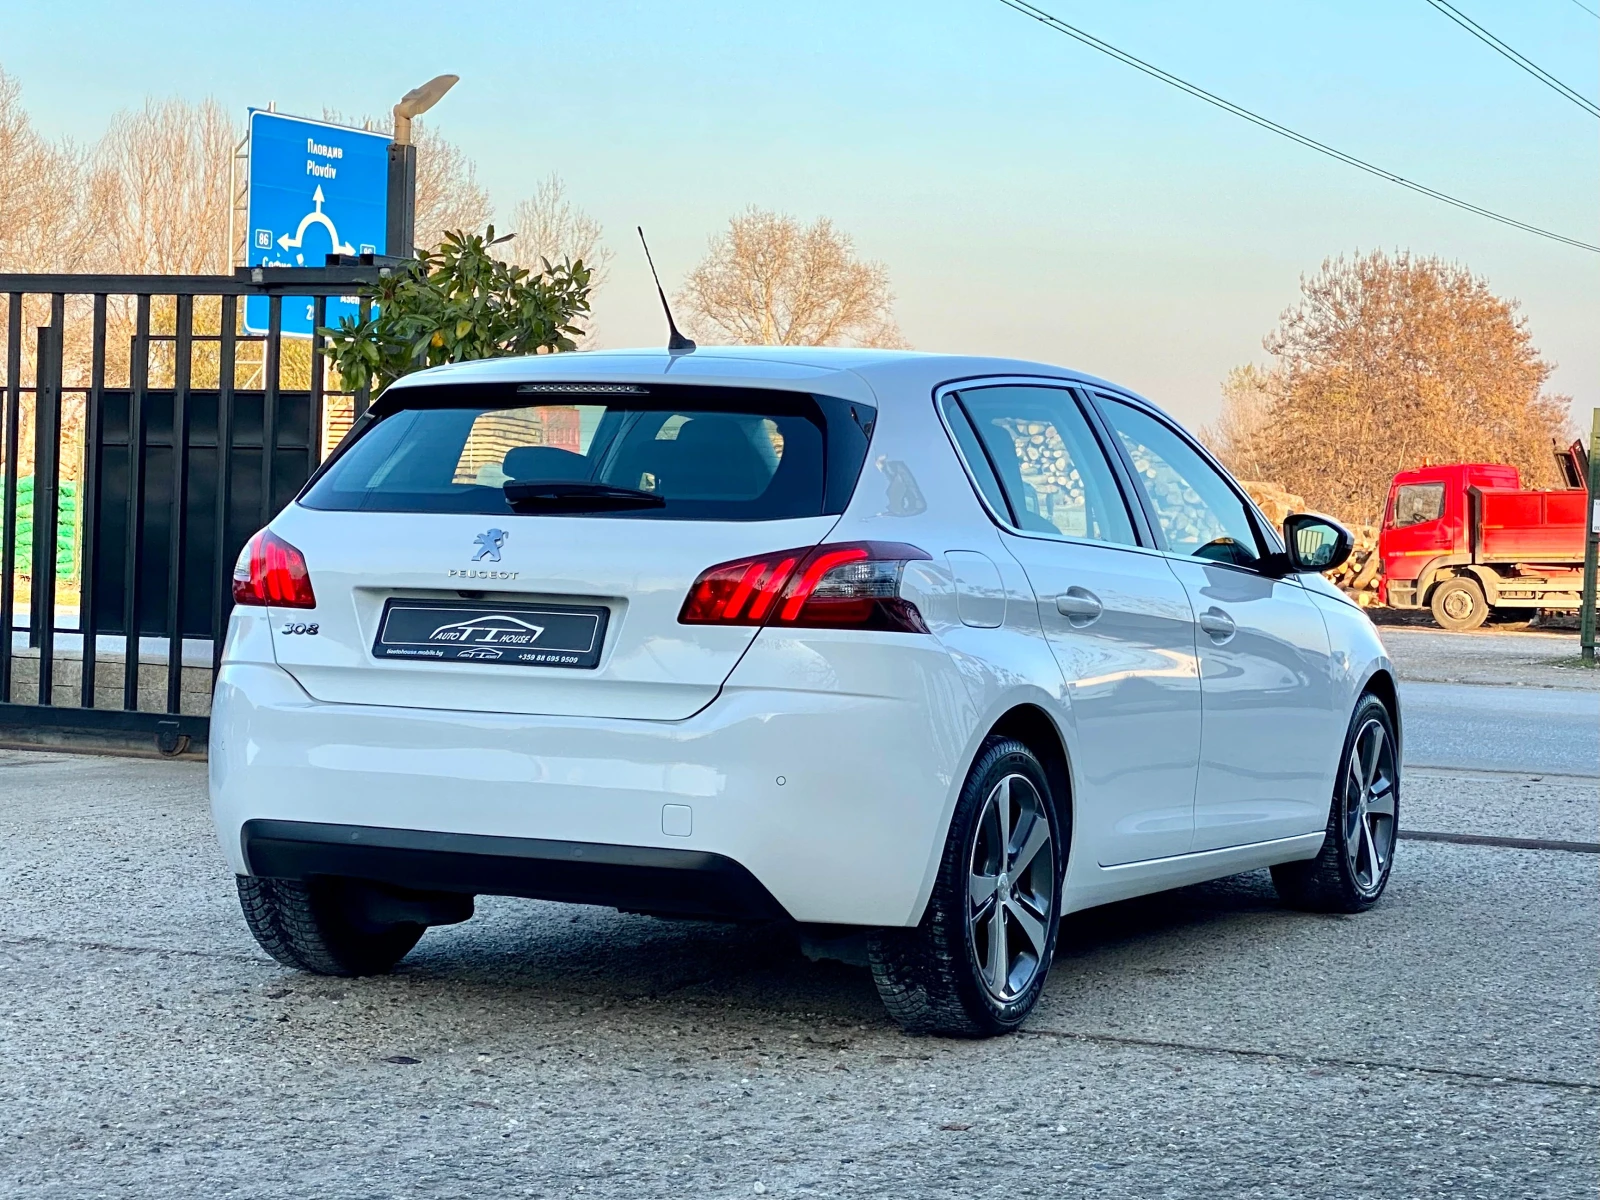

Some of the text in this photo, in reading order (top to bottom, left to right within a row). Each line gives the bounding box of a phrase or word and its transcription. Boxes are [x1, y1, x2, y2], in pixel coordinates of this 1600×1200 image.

[307, 138, 343, 160] Пловдив
[306, 160, 337, 180] Plovdiv
[258, 233, 269, 246] 86
[447, 569, 519, 580] PEUGEOT
[281, 622, 320, 636] 308
[435, 632, 460, 641] AUTO
[499, 635, 531, 644] HOUSE
[518, 653, 535, 661] +359
[560, 656, 579, 664] 9509
